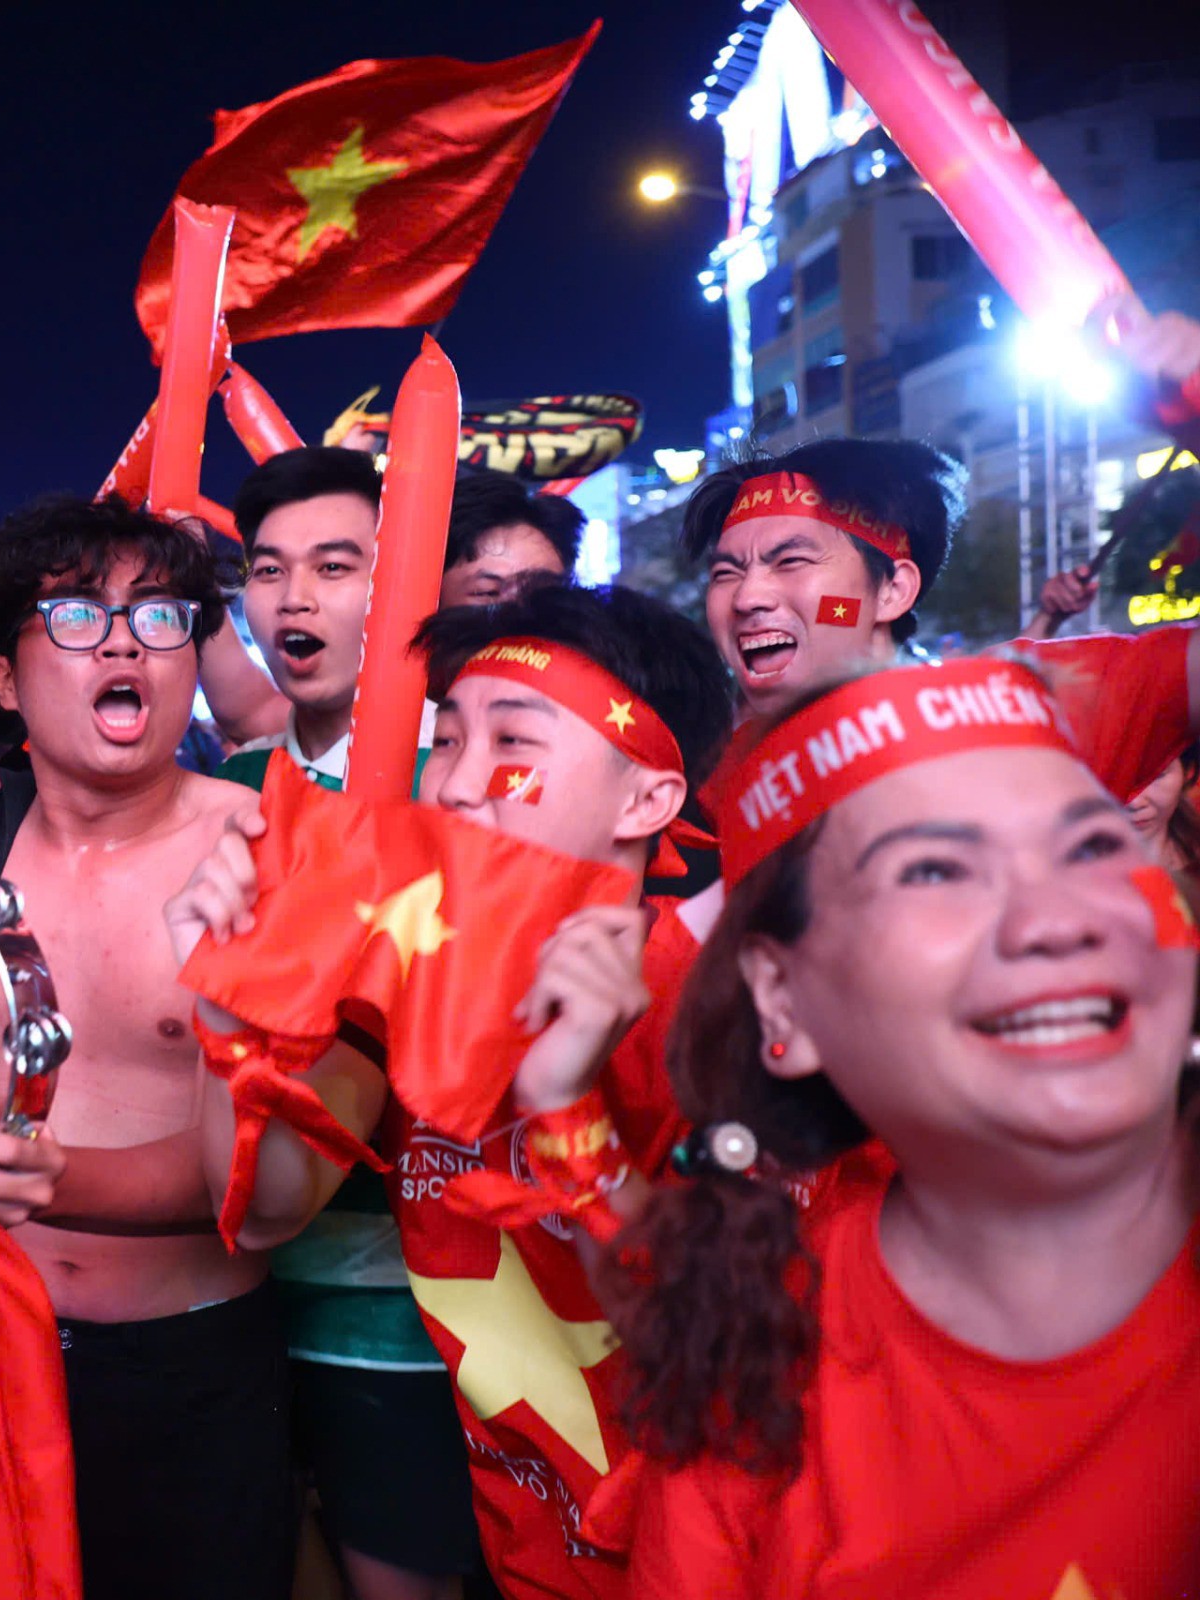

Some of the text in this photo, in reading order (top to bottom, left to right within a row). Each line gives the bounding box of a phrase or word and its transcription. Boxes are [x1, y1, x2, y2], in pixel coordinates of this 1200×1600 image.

[731, 489, 773, 517] AM
[738, 753, 805, 831] VIỆT
[807, 699, 906, 778] NAM
[916, 671, 1049, 731] CHIẾN
[398, 1150, 485, 1175] MANSIO
